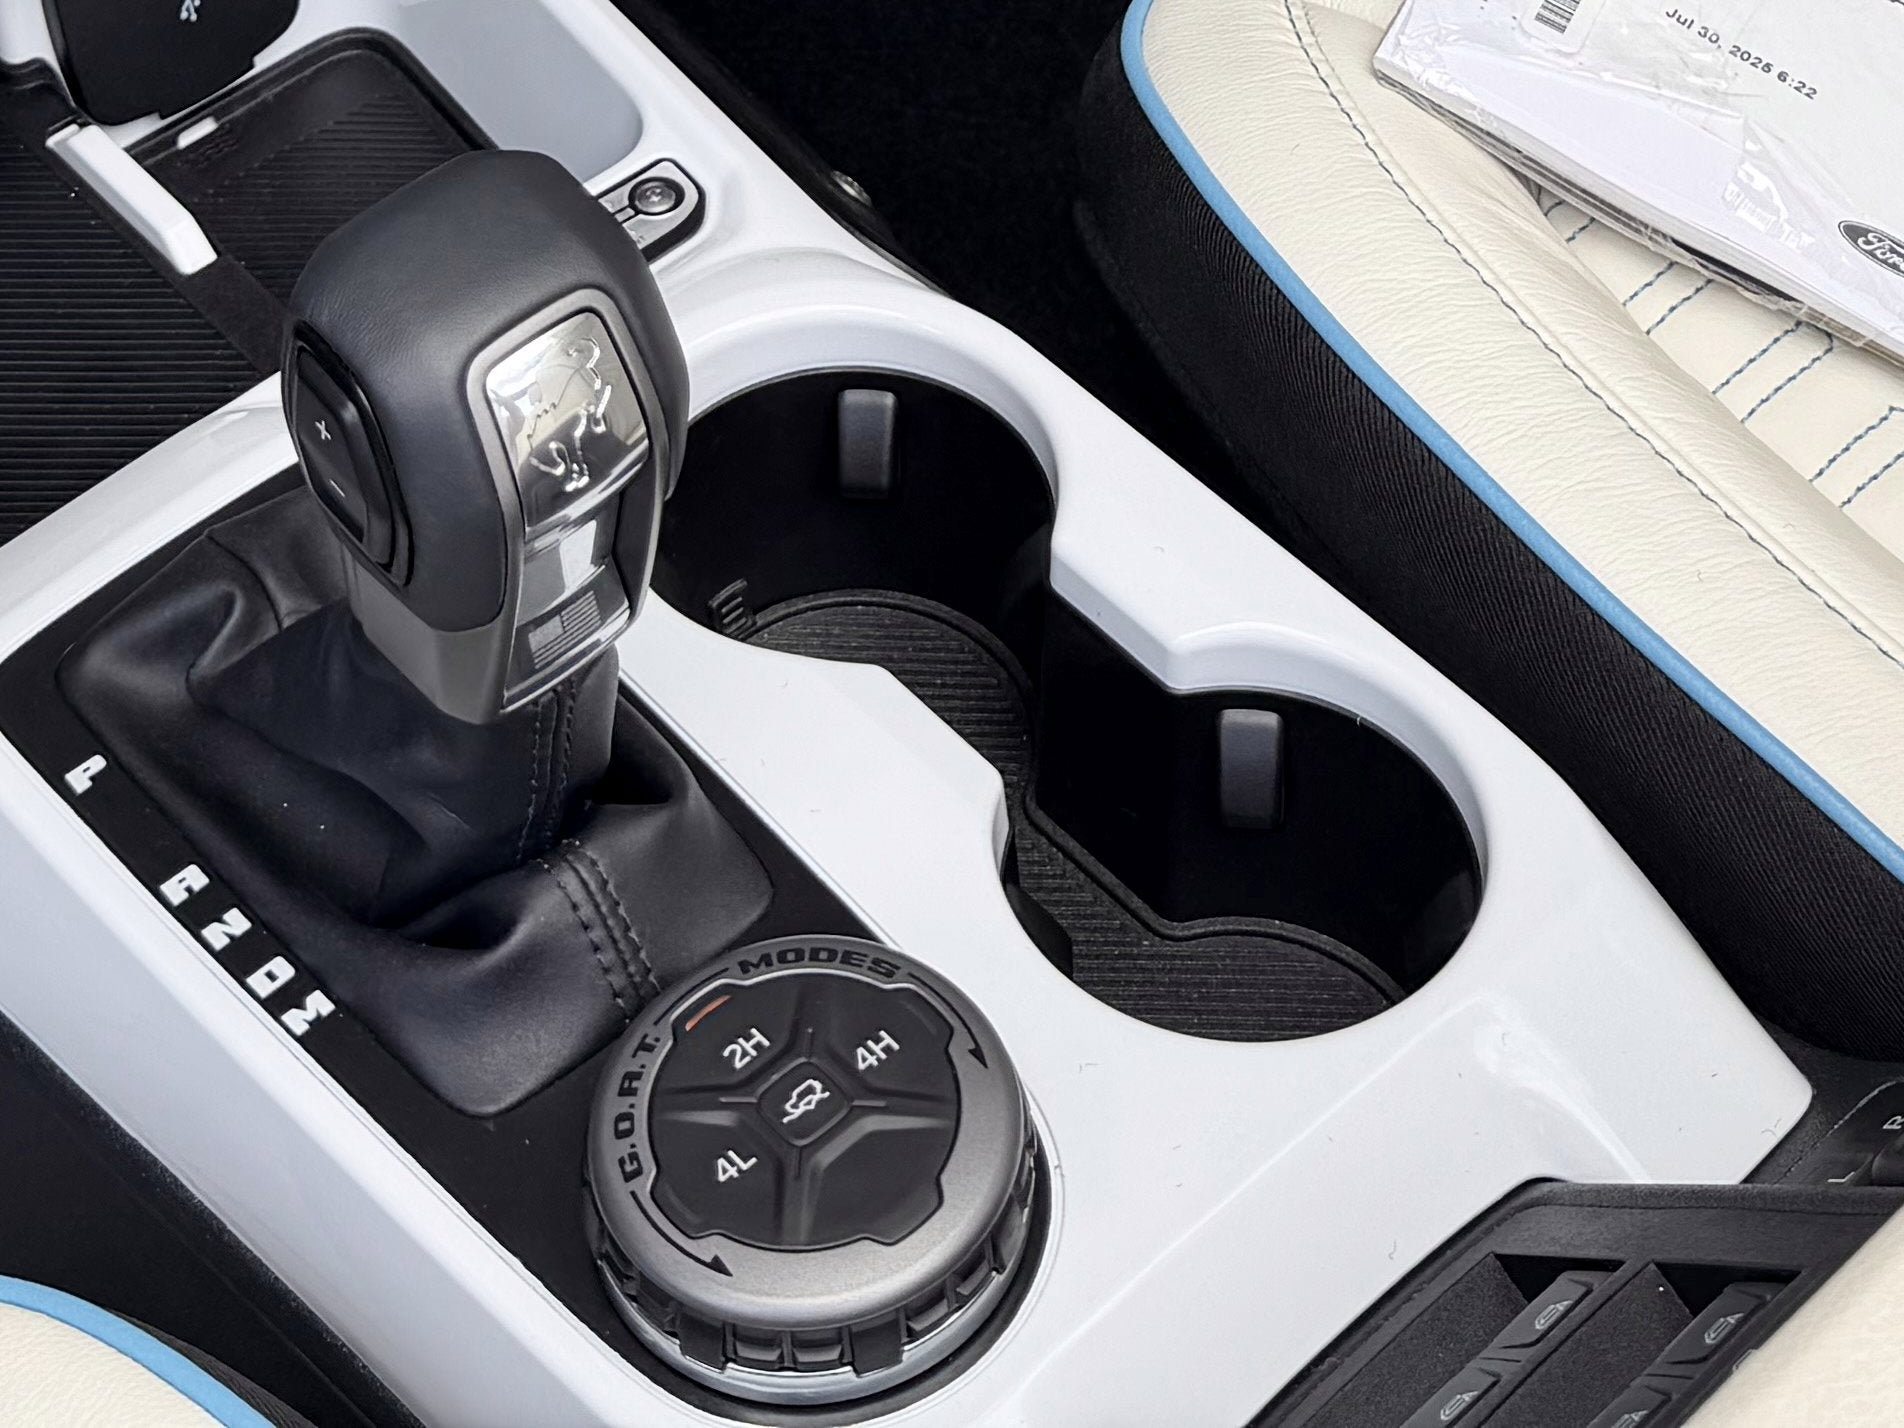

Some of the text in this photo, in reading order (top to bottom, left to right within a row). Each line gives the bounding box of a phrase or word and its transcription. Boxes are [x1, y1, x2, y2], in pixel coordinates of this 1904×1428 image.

[1665, 9, 1818, 100] Jul 30, 2025 6:22
[65, 754, 108, 797] P
[159, 863, 210, 908] R
[202, 907, 253, 952] N
[246, 955, 297, 1002] D
[281, 987, 338, 1037] M
[614, 945, 902, 1184] G.O.A.T. MODES
[722, 1028, 771, 1070] 2H
[854, 1028, 901, 1072] 4H
[712, 1146, 759, 1187] 4L
